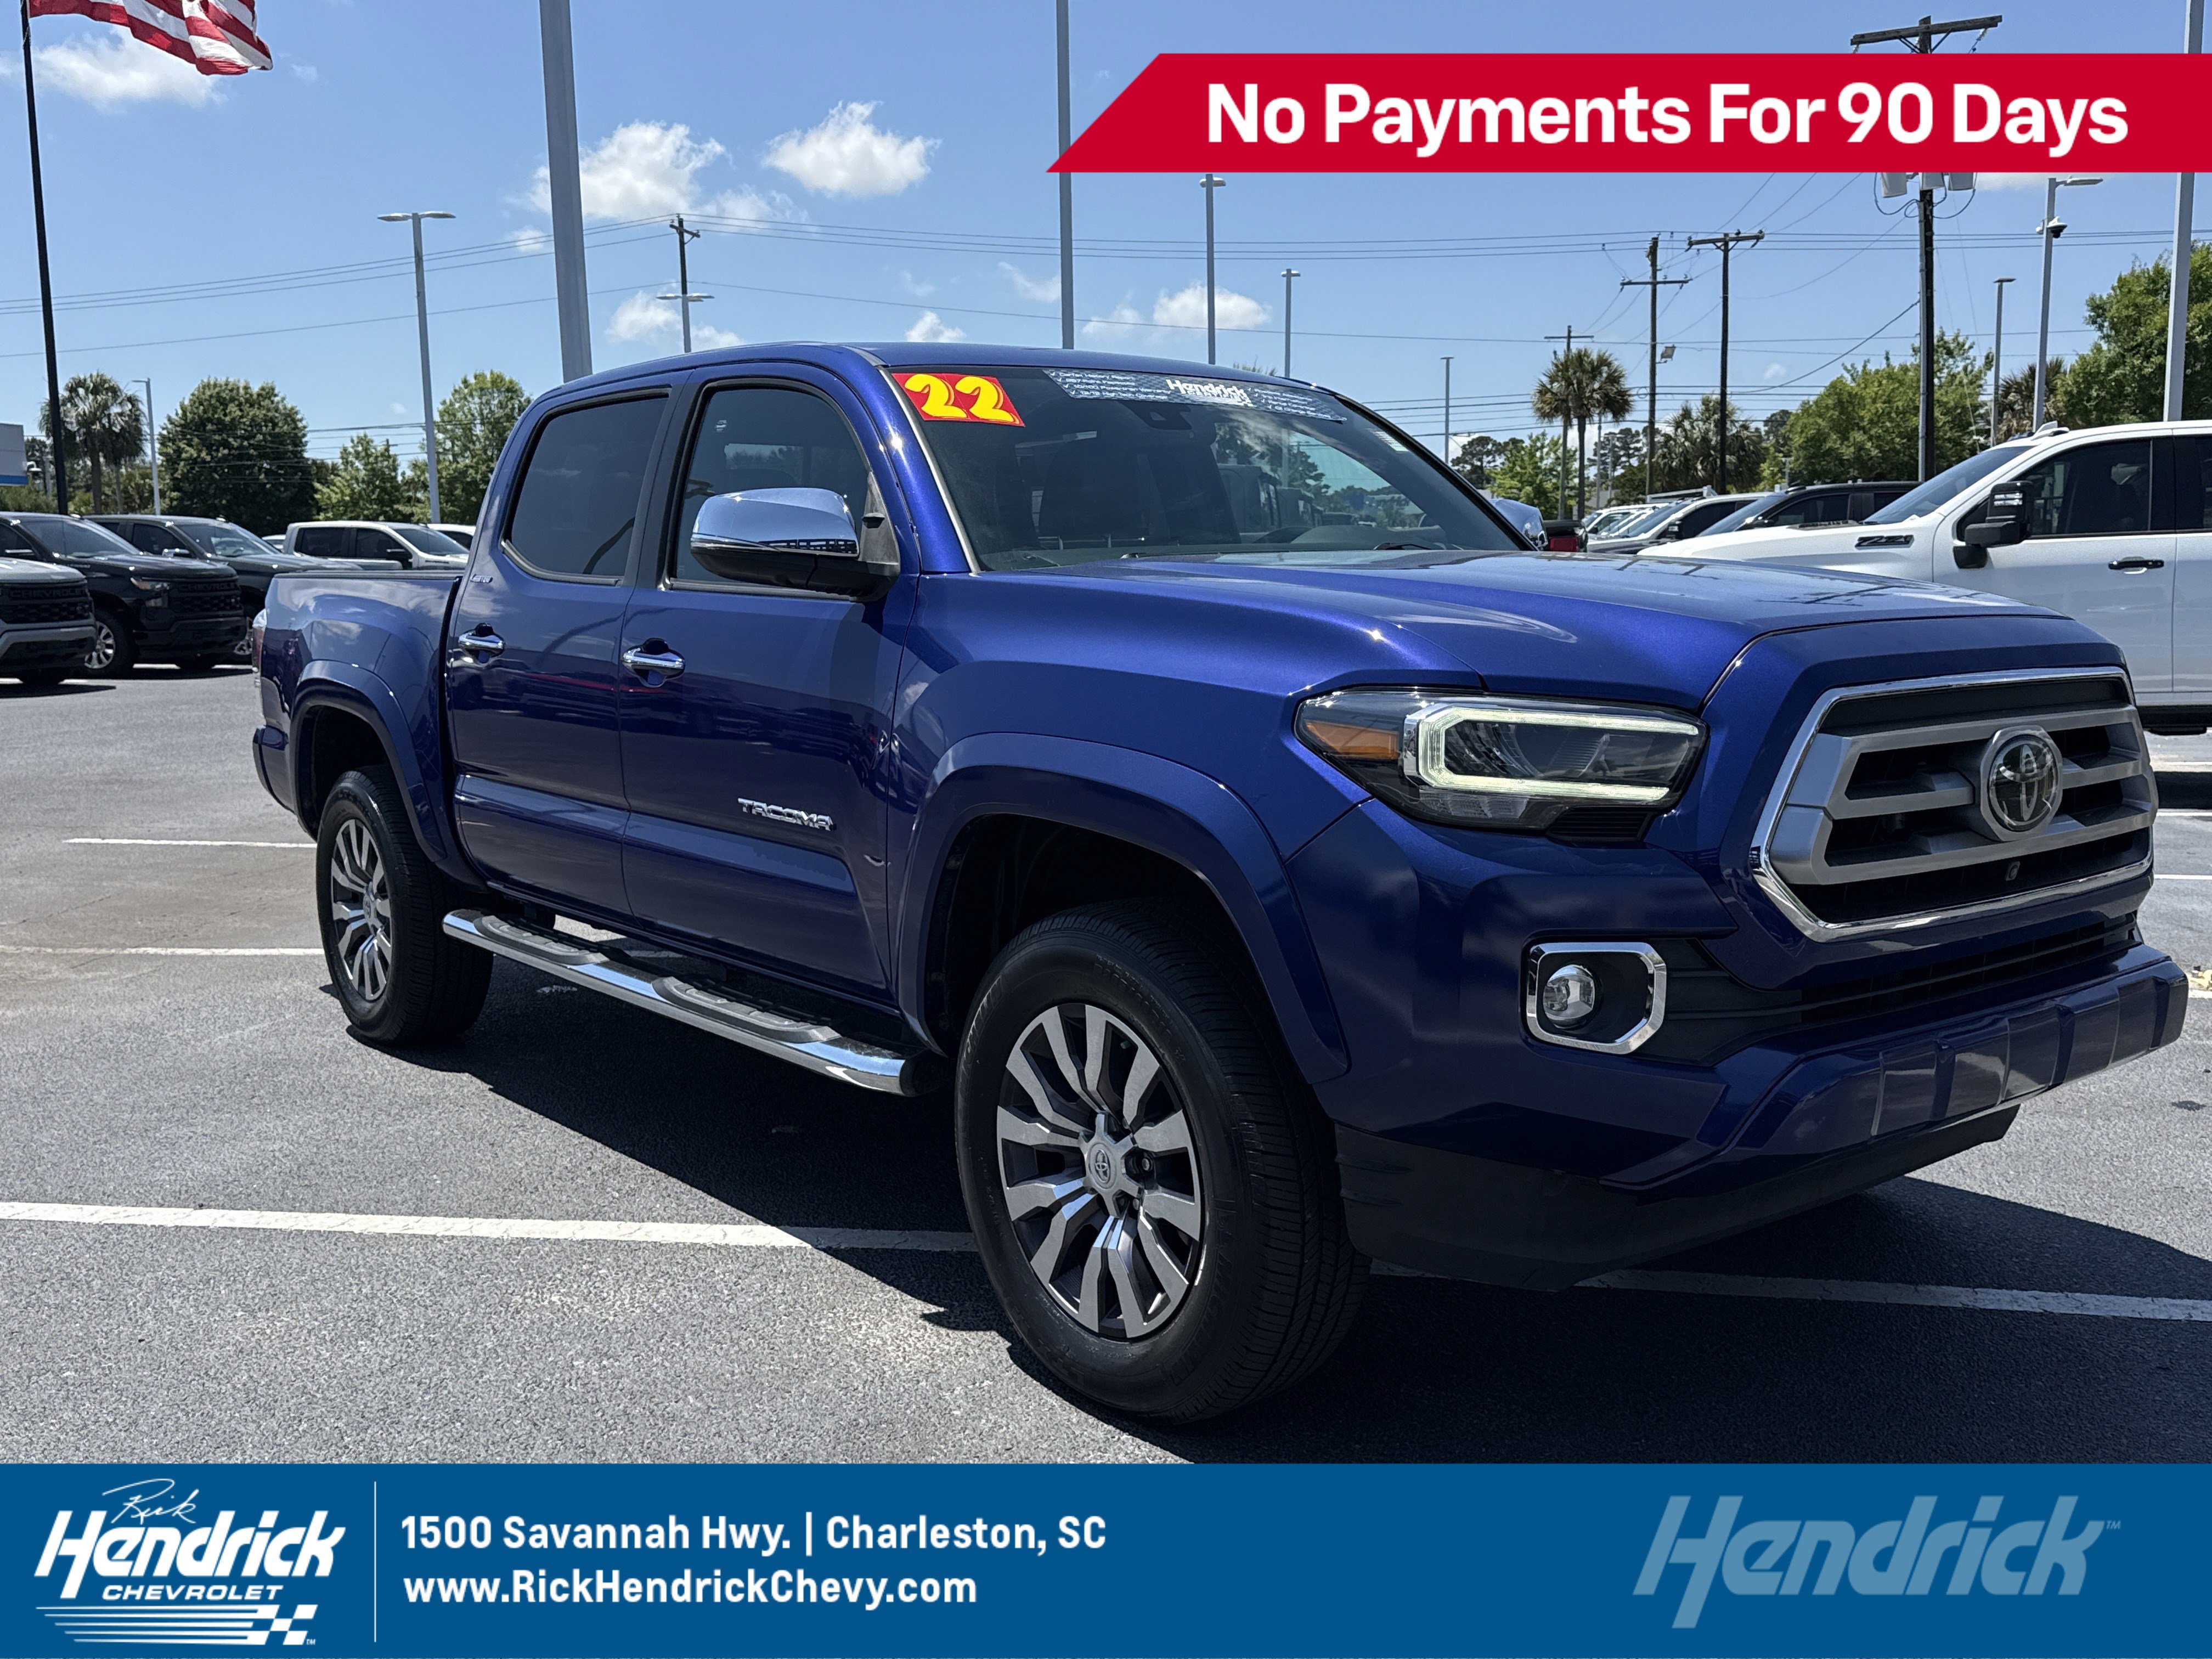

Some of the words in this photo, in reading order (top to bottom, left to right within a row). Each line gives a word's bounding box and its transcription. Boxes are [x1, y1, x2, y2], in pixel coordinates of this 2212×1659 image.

[905, 374, 1020, 425] 22
[1166, 379, 1246, 397] Hendrick
[737, 797, 834, 832] TACOMA
